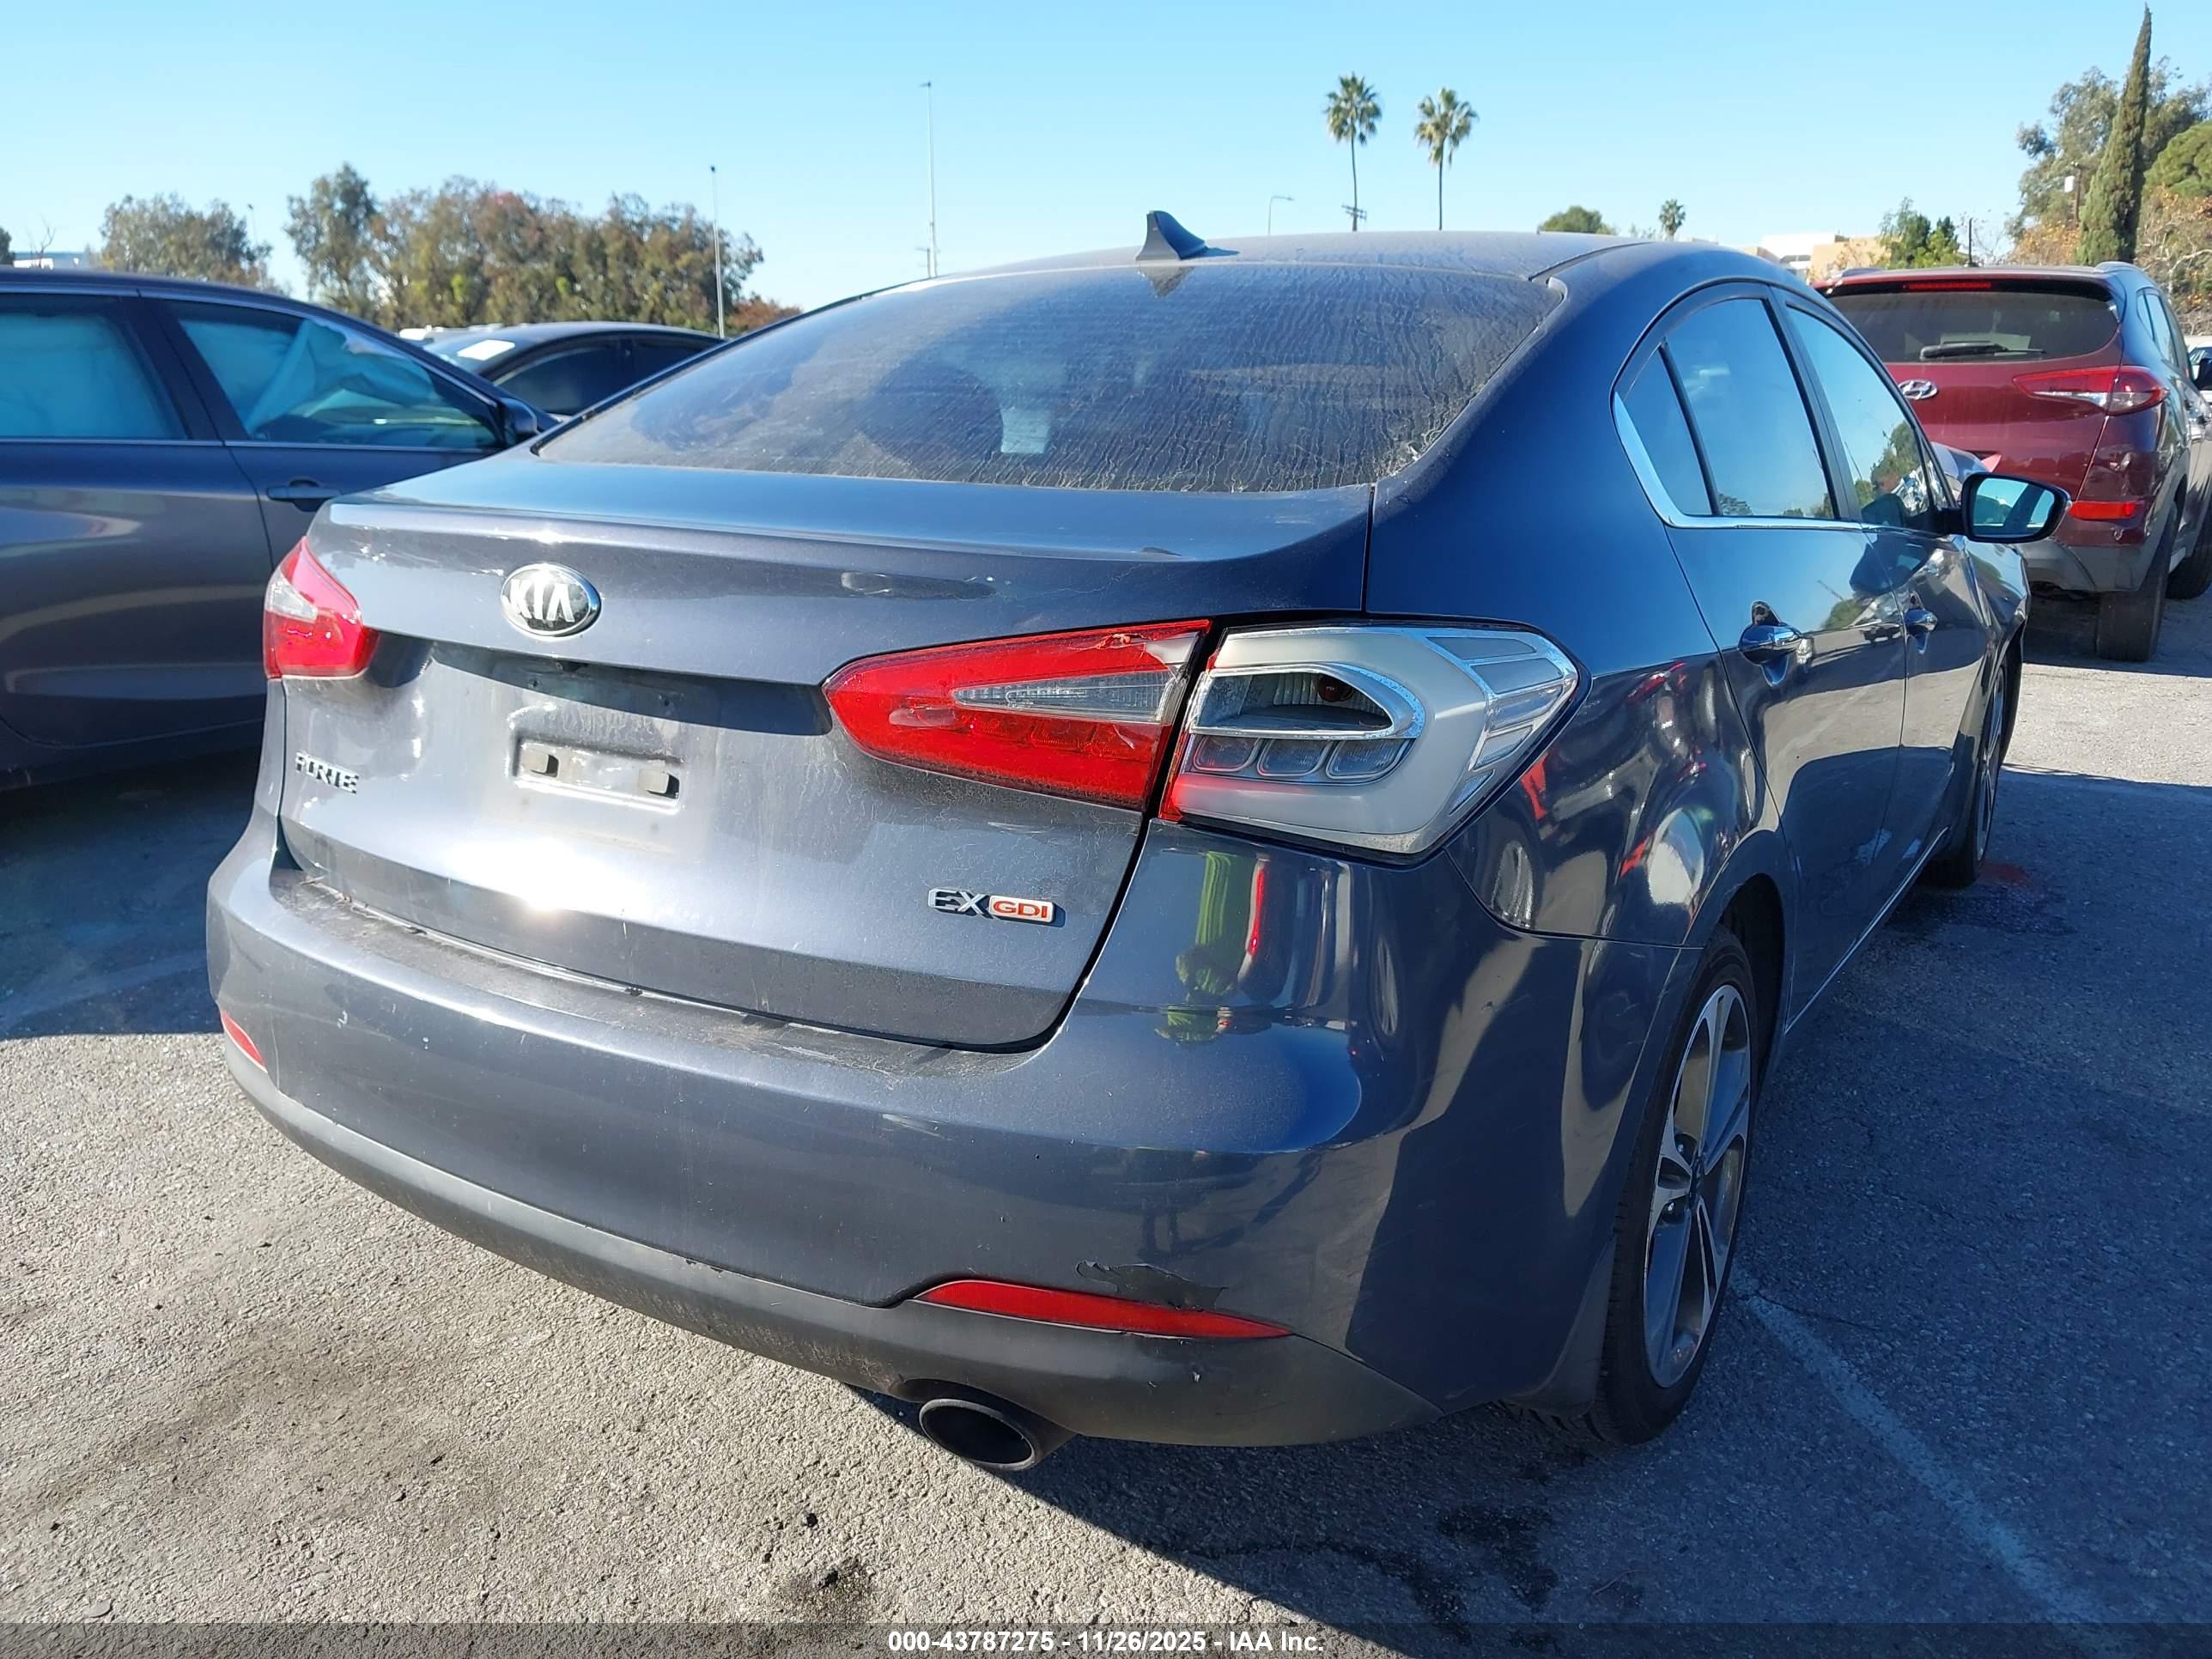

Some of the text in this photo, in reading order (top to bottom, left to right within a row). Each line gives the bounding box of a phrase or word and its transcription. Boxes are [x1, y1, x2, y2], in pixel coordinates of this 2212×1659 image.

[509, 578, 575, 623] KIA
[928, 888, 1048, 919] EX GDI
